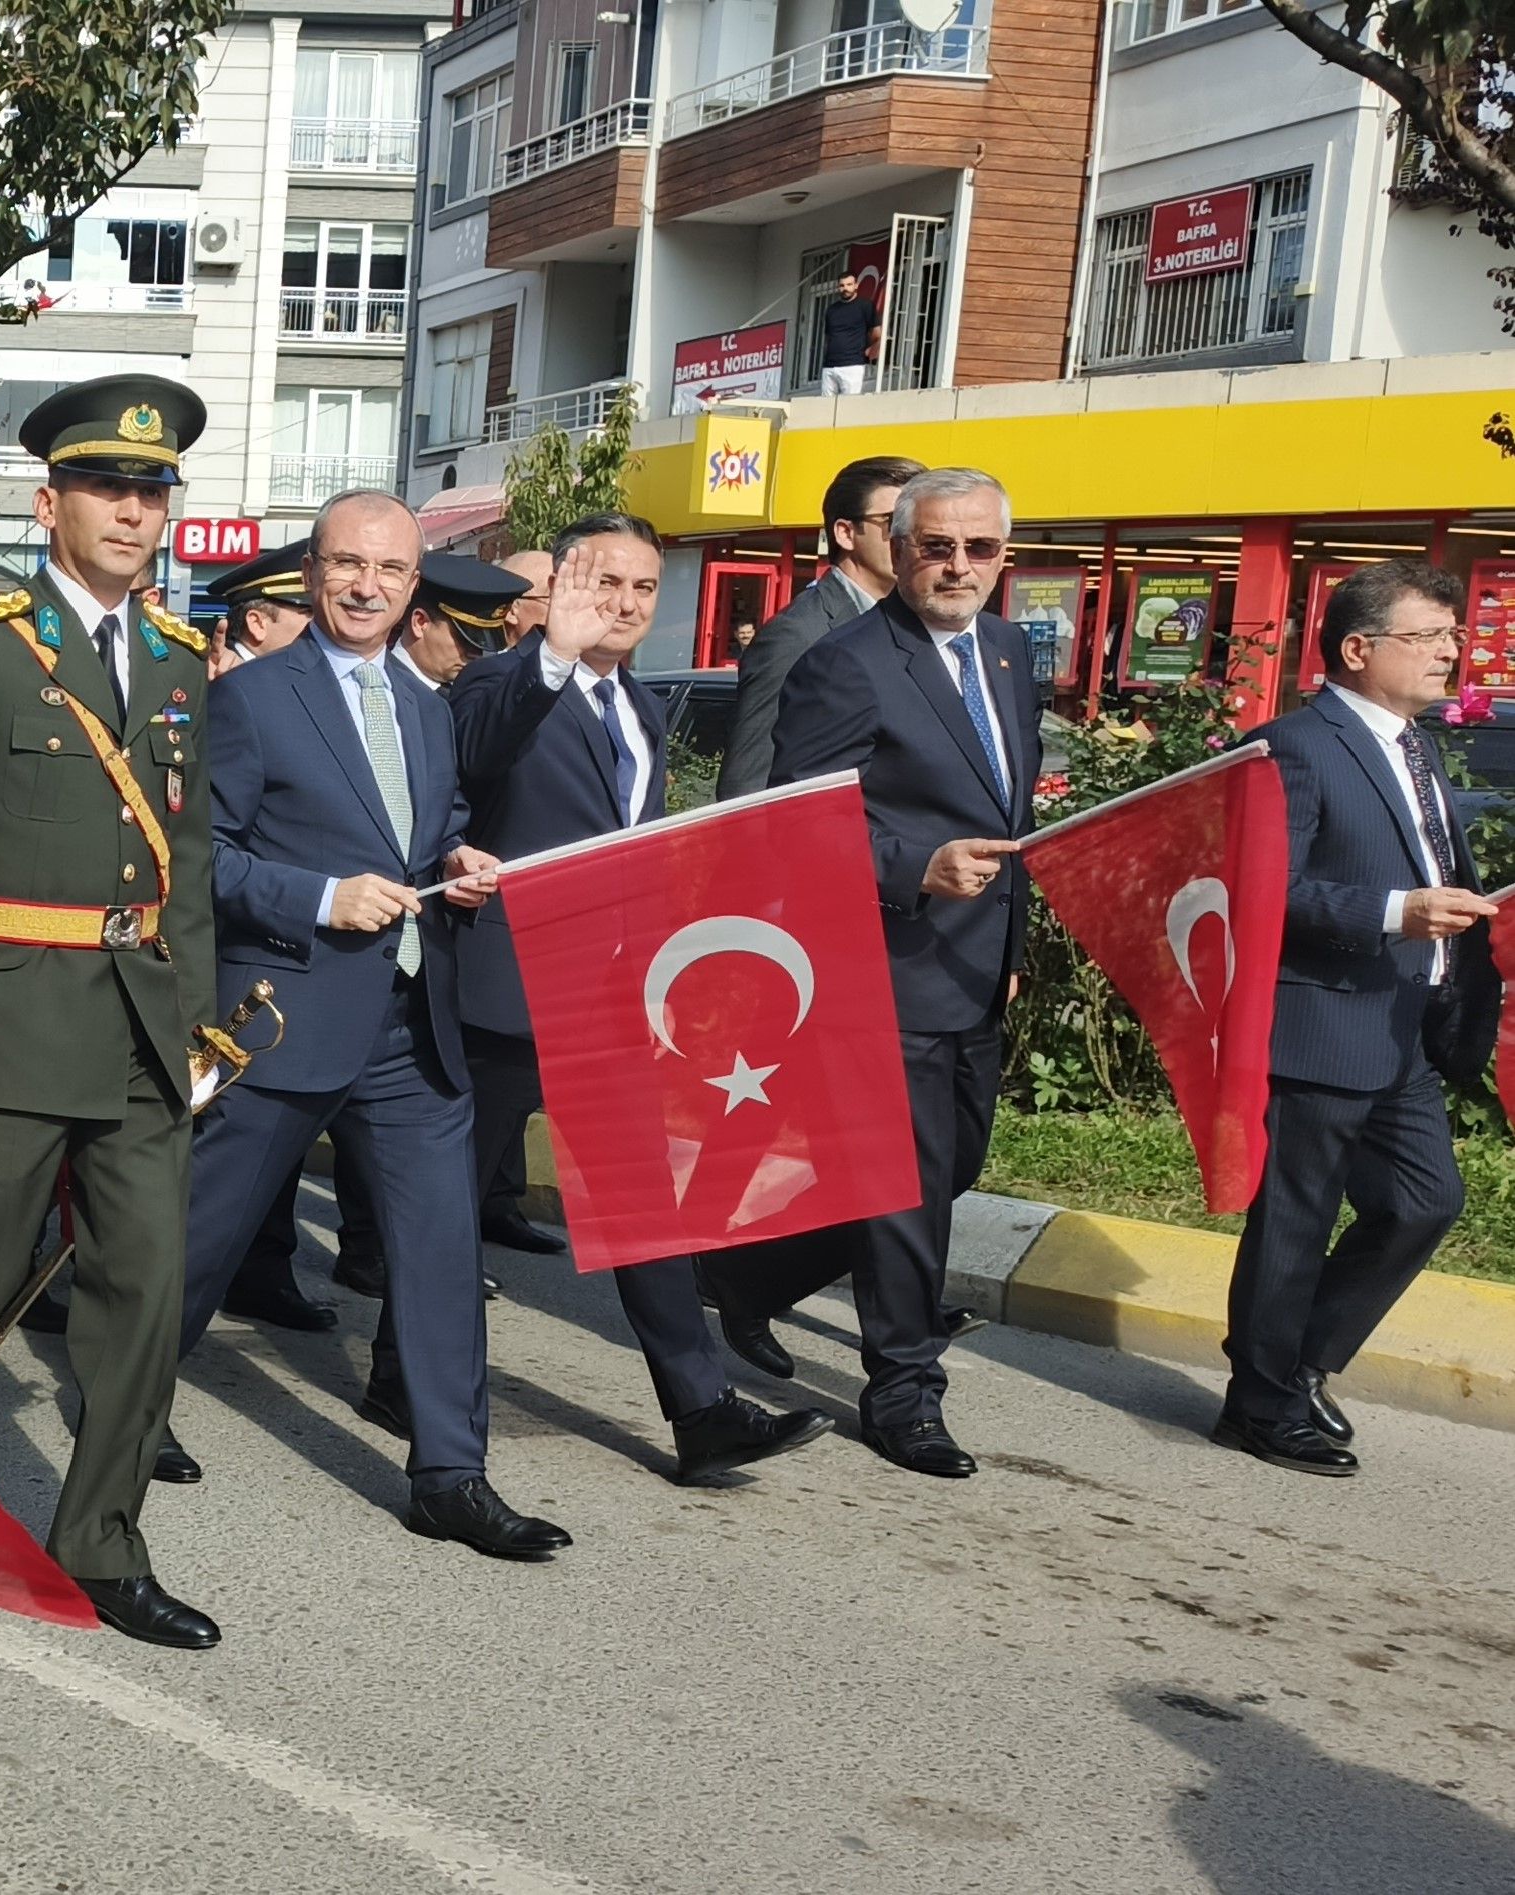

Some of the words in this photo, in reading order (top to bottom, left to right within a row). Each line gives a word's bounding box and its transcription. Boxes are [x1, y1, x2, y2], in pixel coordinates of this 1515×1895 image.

[1188, 200, 1212, 217] T.C.
[1177, 222, 1217, 243] BAFRA
[675, 362, 707, 382] BAFRA
[724, 342, 783, 373] NOTERLİĞİ
[709, 450, 761, 493] ŞOK
[184, 519, 251, 555] BİM
